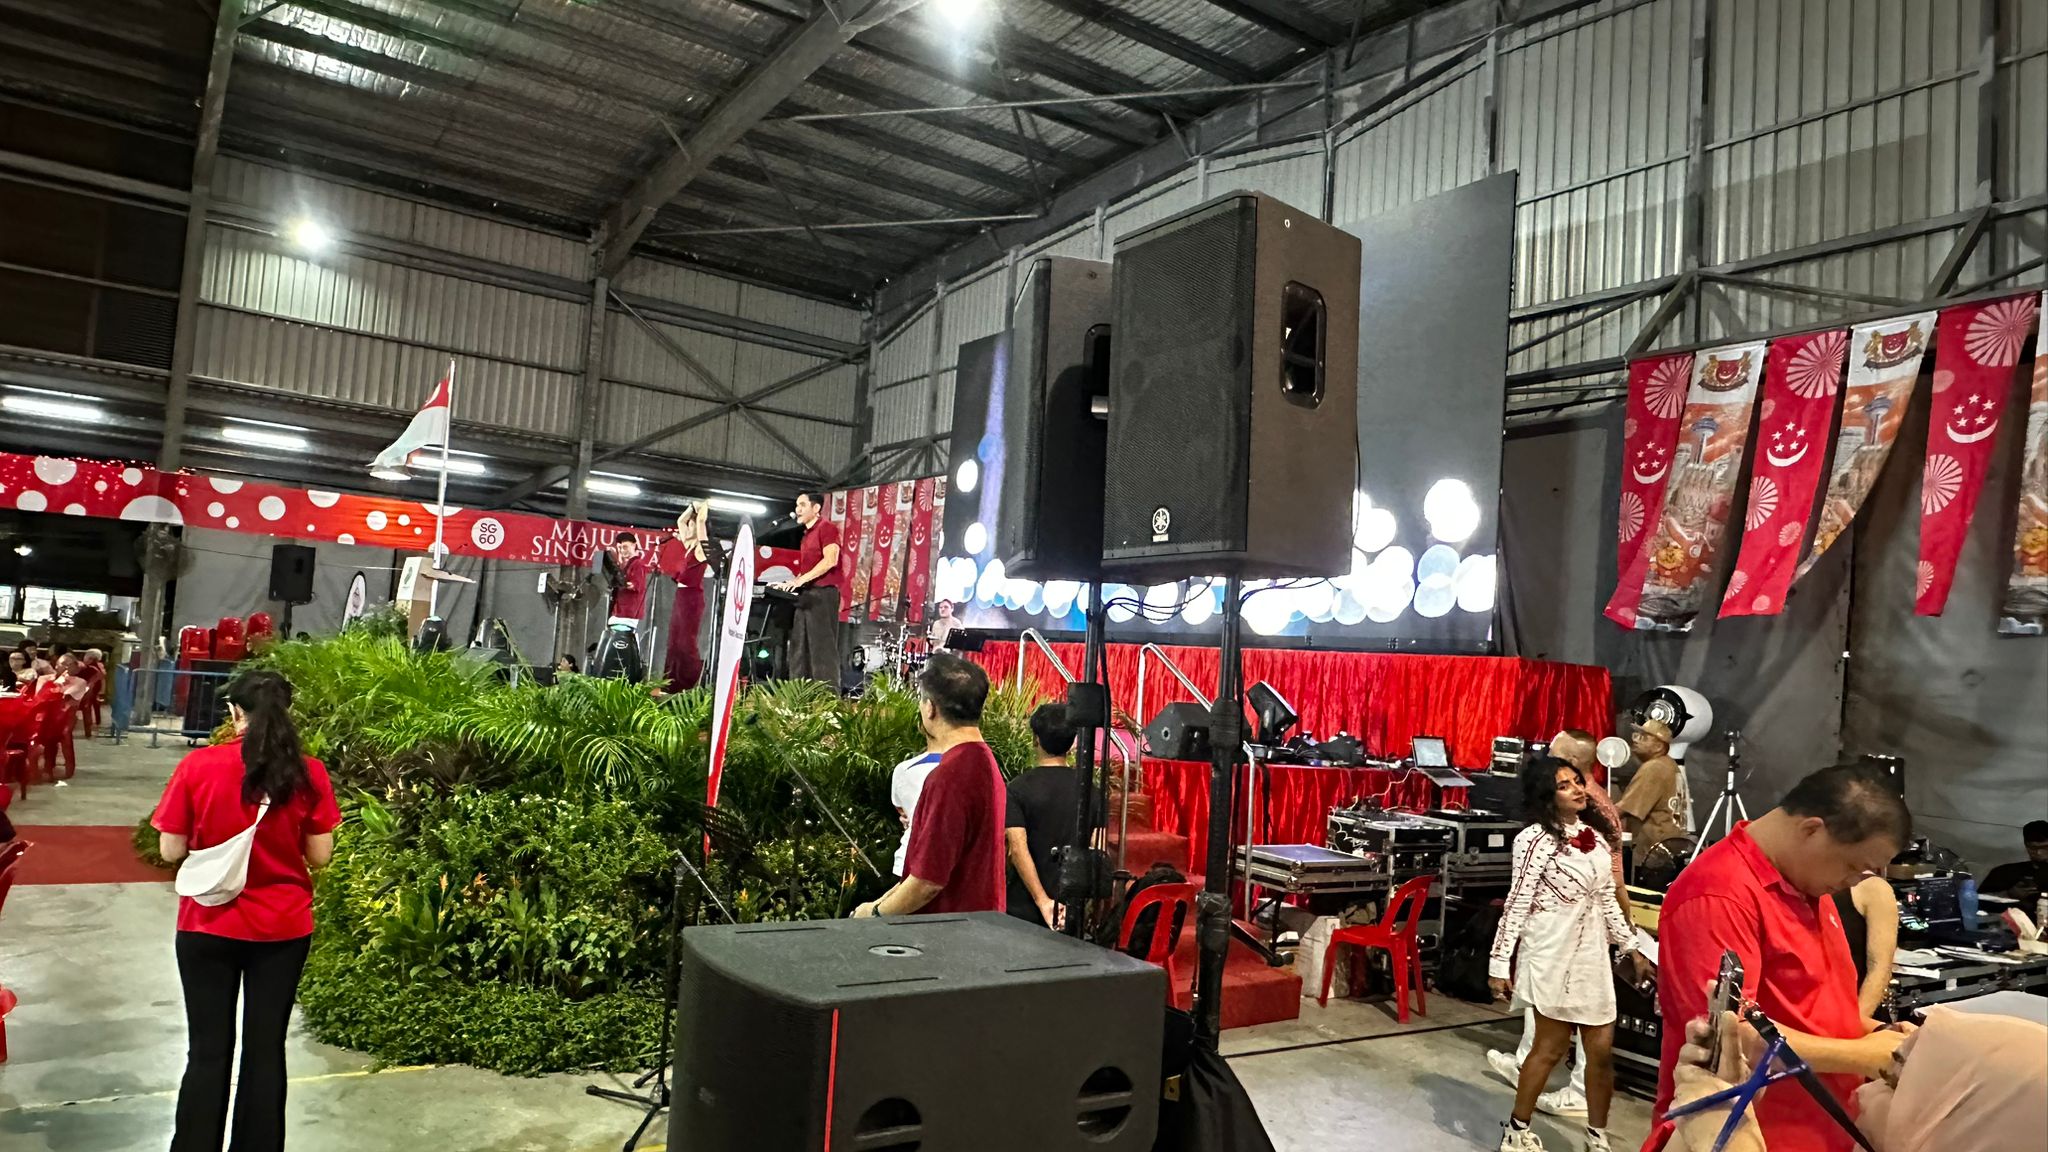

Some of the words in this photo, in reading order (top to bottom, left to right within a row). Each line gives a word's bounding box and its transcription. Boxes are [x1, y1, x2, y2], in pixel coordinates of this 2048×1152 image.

[478, 533, 497, 545] 60
[479, 522, 498, 534] SG
[550, 520, 660, 552] MAJUAH
[531, 535, 662, 569] SINGAA
